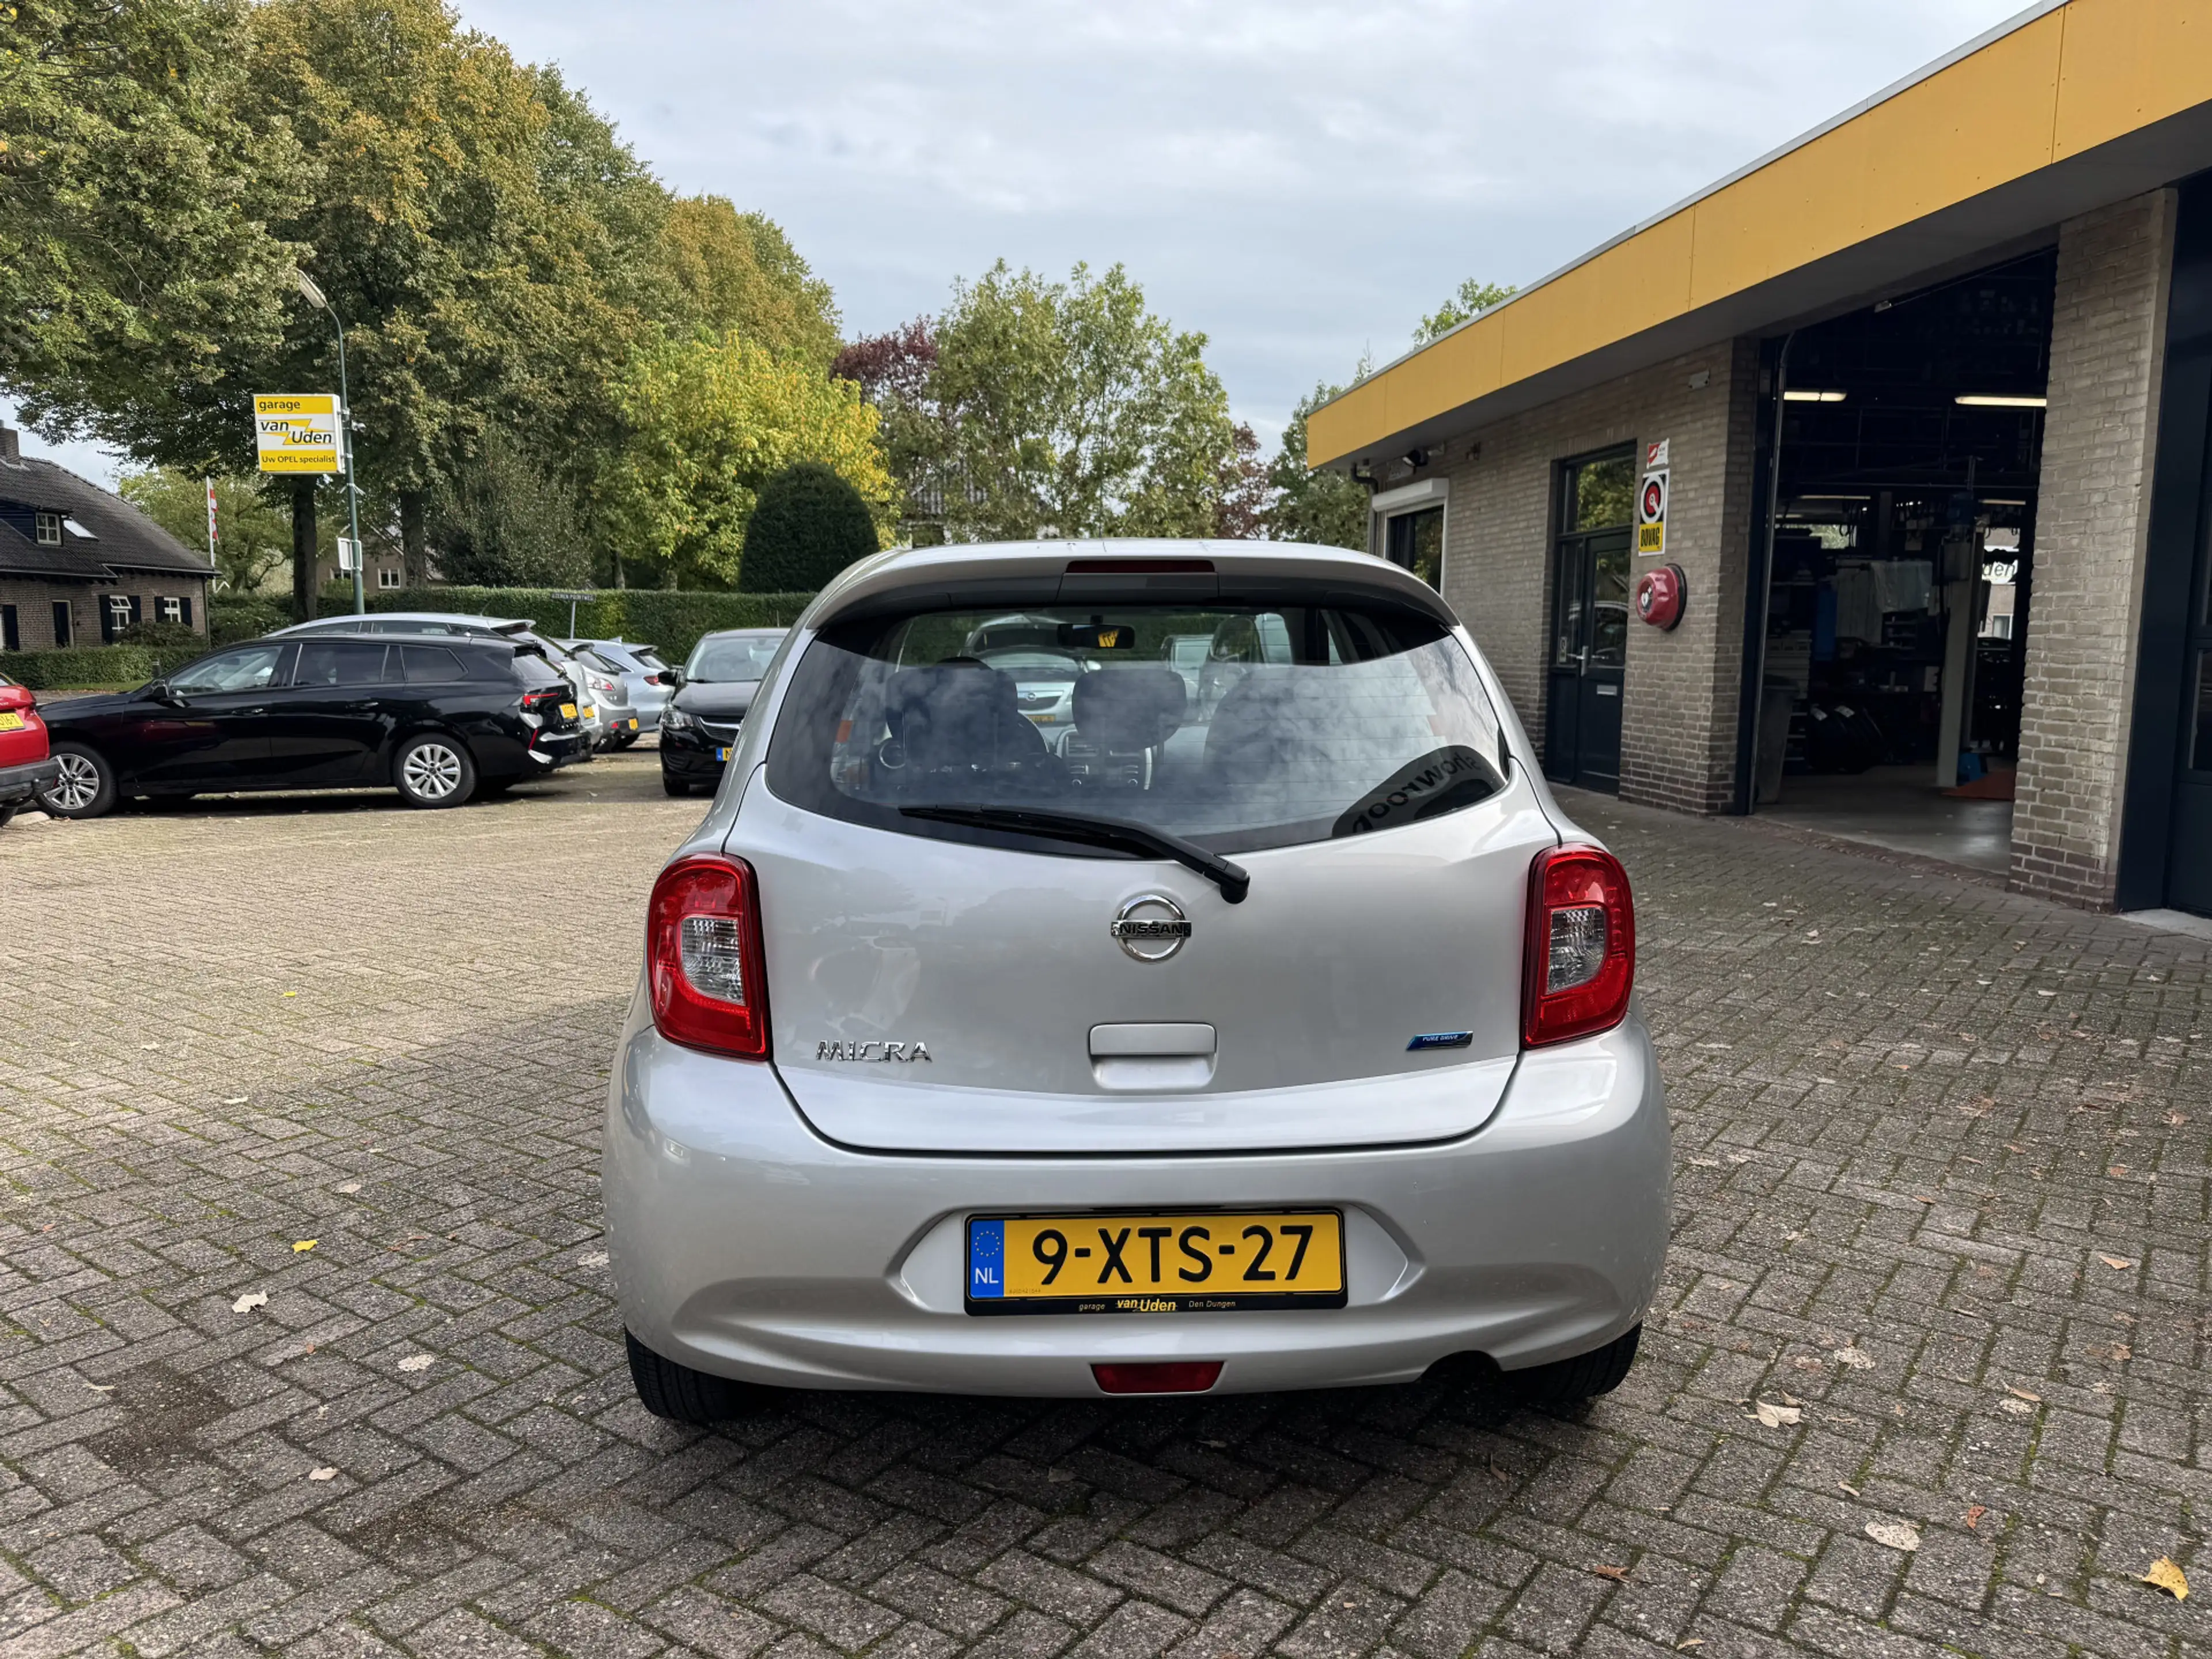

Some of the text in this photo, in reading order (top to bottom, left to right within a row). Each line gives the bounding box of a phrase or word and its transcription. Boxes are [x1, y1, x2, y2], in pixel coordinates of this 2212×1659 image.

[259, 401, 301, 412] garage
[260, 421, 332, 444] van Uden
[300, 455, 336, 464] specialist
[1641, 527, 1660, 547] BOVAG
[1119, 922, 1183, 935] NISSAN
[815, 1040, 933, 1063] MICRA
[1032, 1225, 1313, 1285] 9-XTS-27
[975, 1267, 999, 1284] NL
[1078, 1303, 1105, 1312] garage
[1117, 1299, 1137, 1308] van
[1141, 1298, 1176, 1312] Uden
